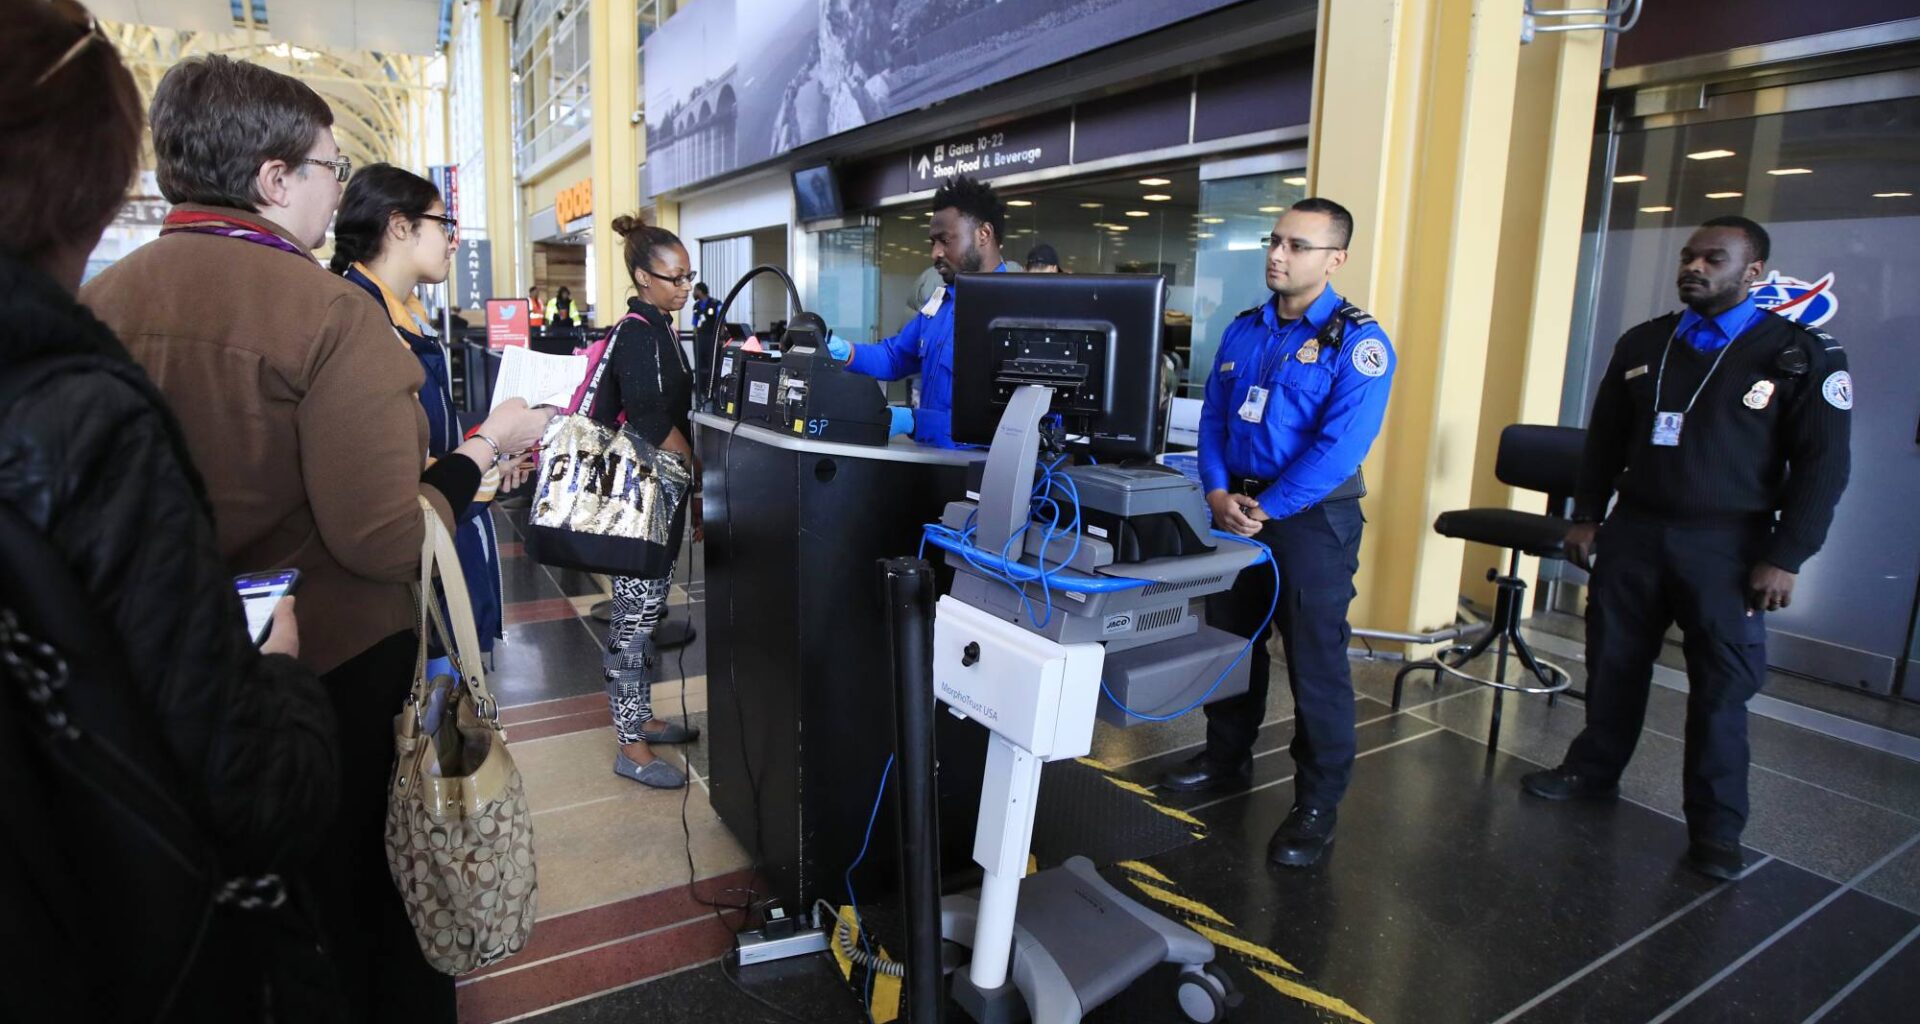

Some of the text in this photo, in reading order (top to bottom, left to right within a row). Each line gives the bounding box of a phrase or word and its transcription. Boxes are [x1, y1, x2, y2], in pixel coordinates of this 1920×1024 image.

[948, 133, 1004, 157] Gates 10-22
[933, 148, 1041, 178] Shop/Food & Beverage
[468, 240, 481, 310] CANTINA
[808, 419, 829, 436] SP
[540, 450, 658, 516] PINK
[1106, 619, 1128, 629] JACO
[941, 681, 998, 720] MorphoTrust USA
